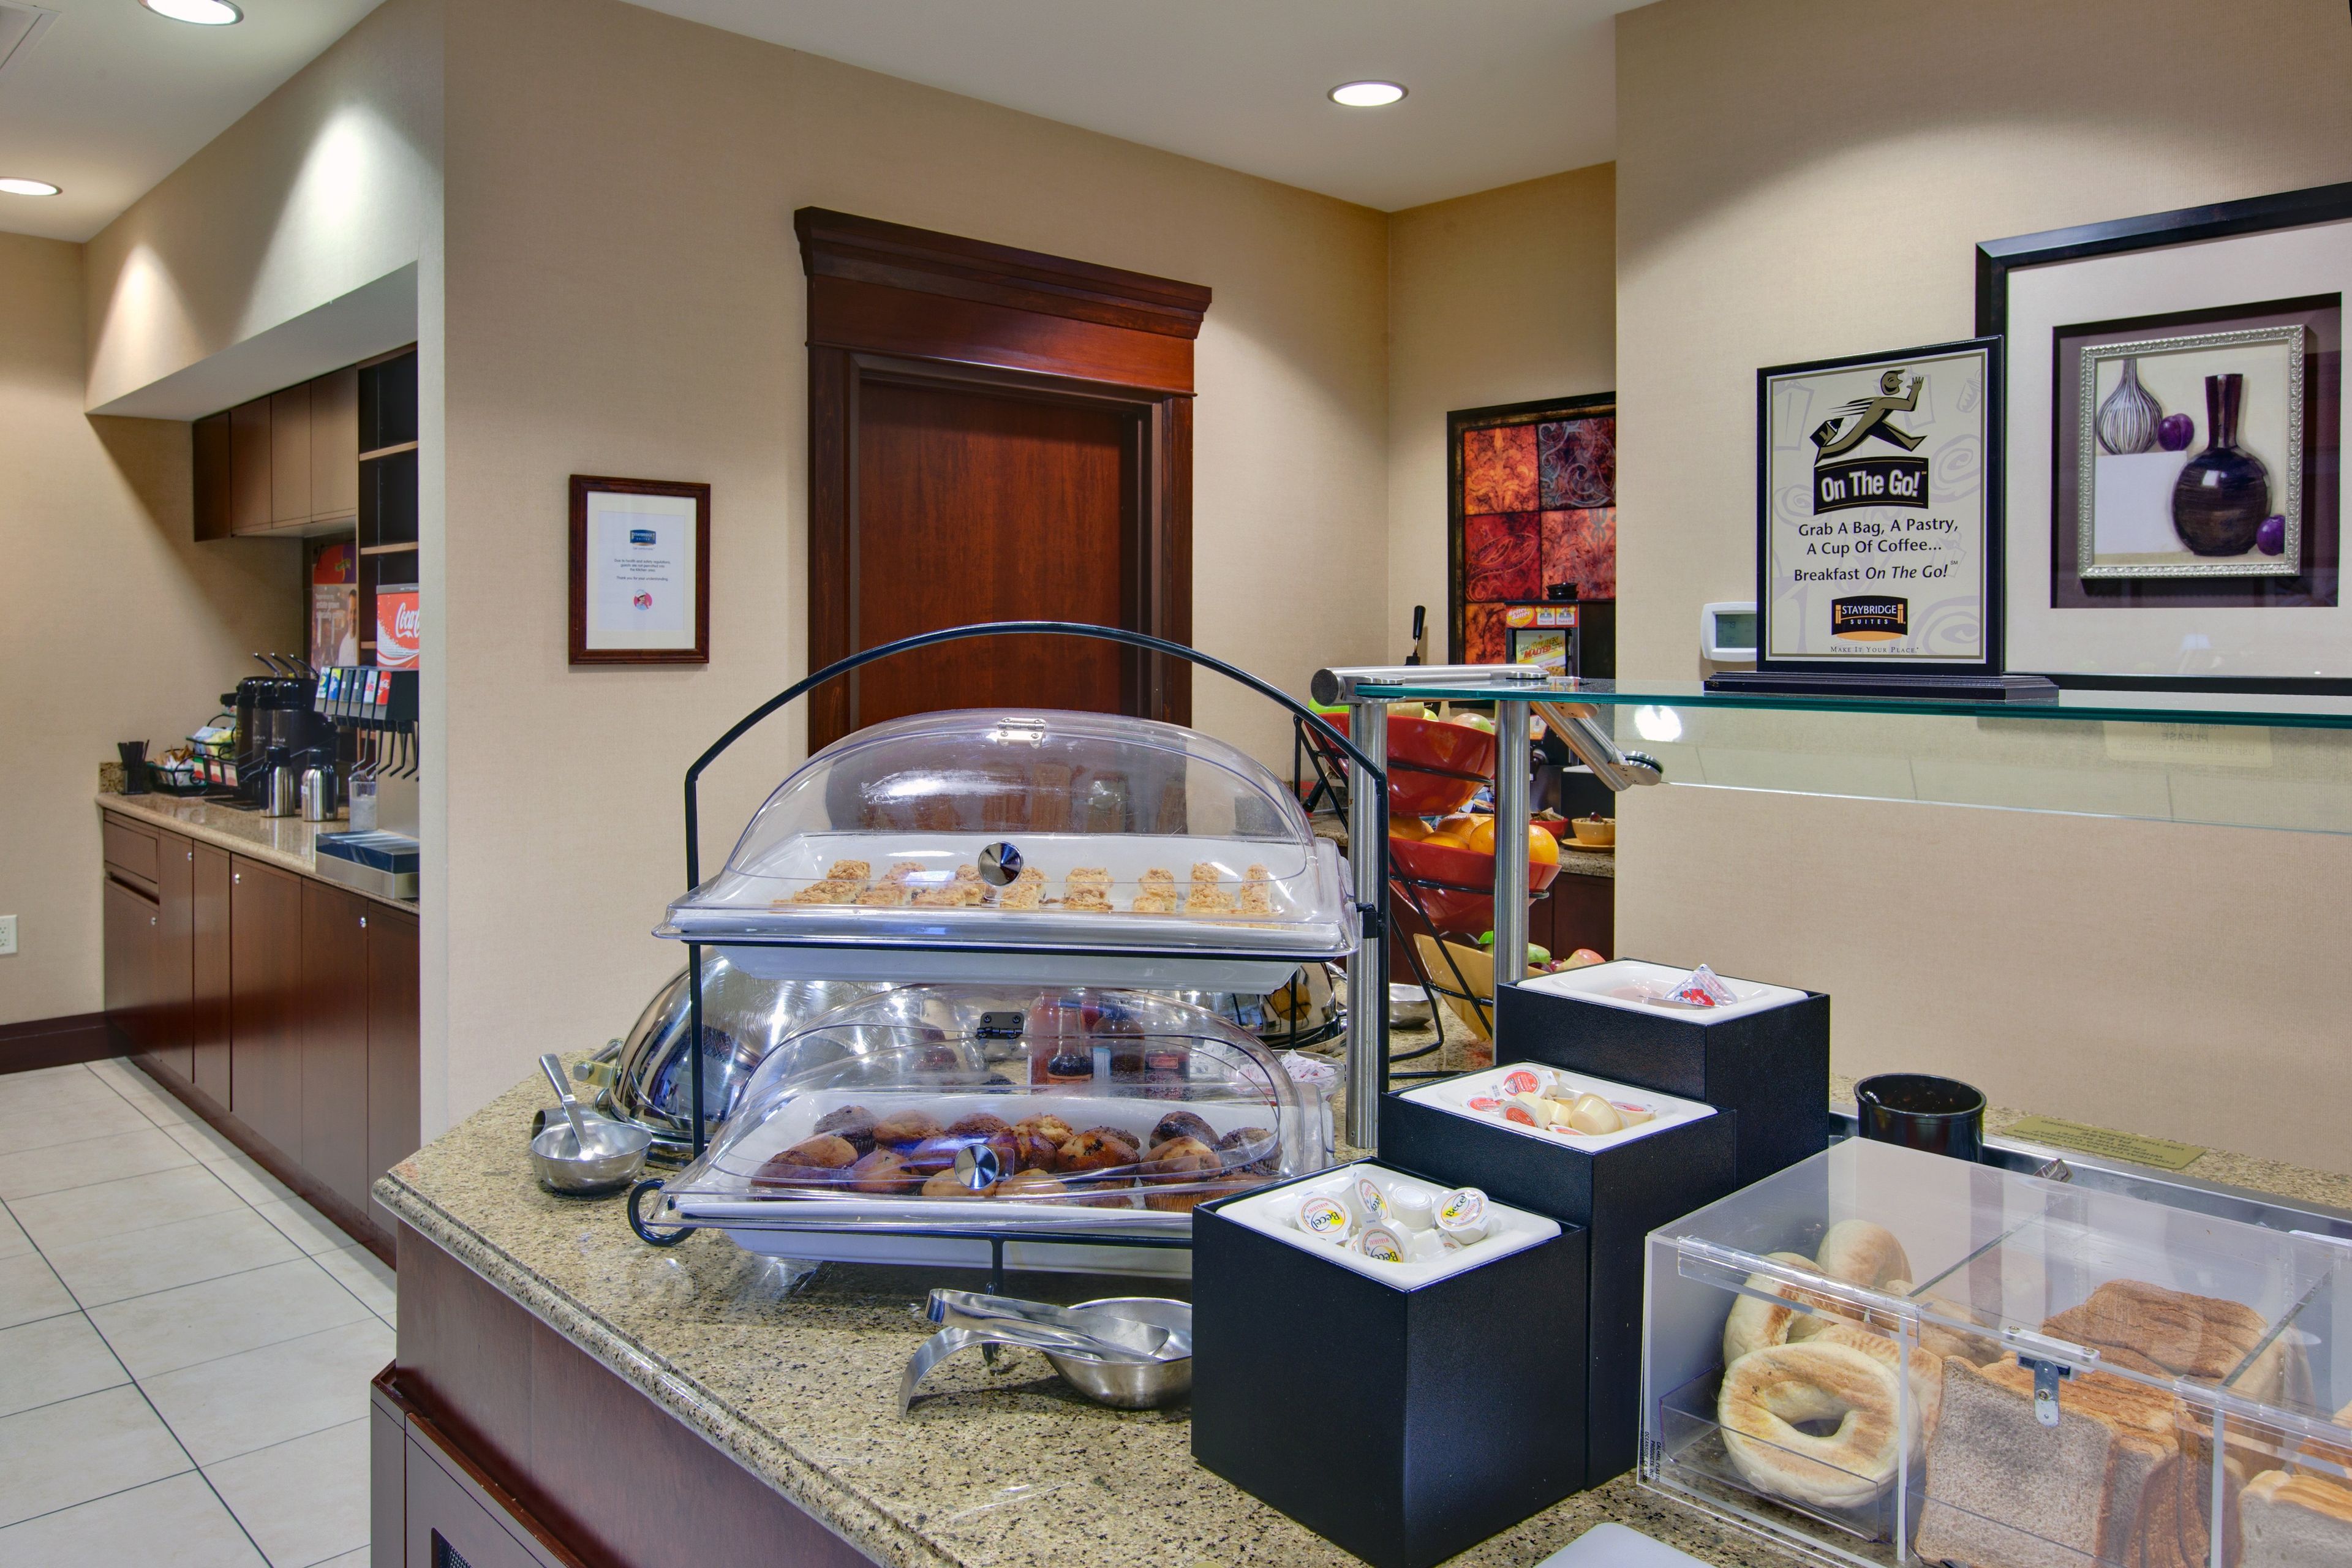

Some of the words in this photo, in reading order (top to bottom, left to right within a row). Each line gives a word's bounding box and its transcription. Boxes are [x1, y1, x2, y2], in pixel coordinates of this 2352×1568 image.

[1821, 476, 1846, 503] On
[1849, 469, 1885, 497] The
[1888, 469, 1921, 498] Go!
[1798, 522, 1833, 537] Grab
[1838, 522, 1849, 535] A
[1853, 521, 1885, 537] Bag,
[1890, 519, 1902, 533] A
[1907, 518, 1959, 533] Pastry,
[1806, 543, 1817, 556] A
[1822, 541, 1850, 558] Cup
[1855, 540, 1872, 554] Of
[1877, 537, 1942, 553] Coffee...
[1794, 567, 1860, 581] Breakfast
[1865, 567, 1886, 580] On
[1891, 565, 1917, 579] The
[1922, 564, 1948, 579] Go!
[1841, 605, 1897, 615] STAYBRIDGE
[1523, 644, 1551, 659] MALTED
[1446, 1195, 1467, 1217] Becel
[1313, 1211, 1340, 1228] Becel
